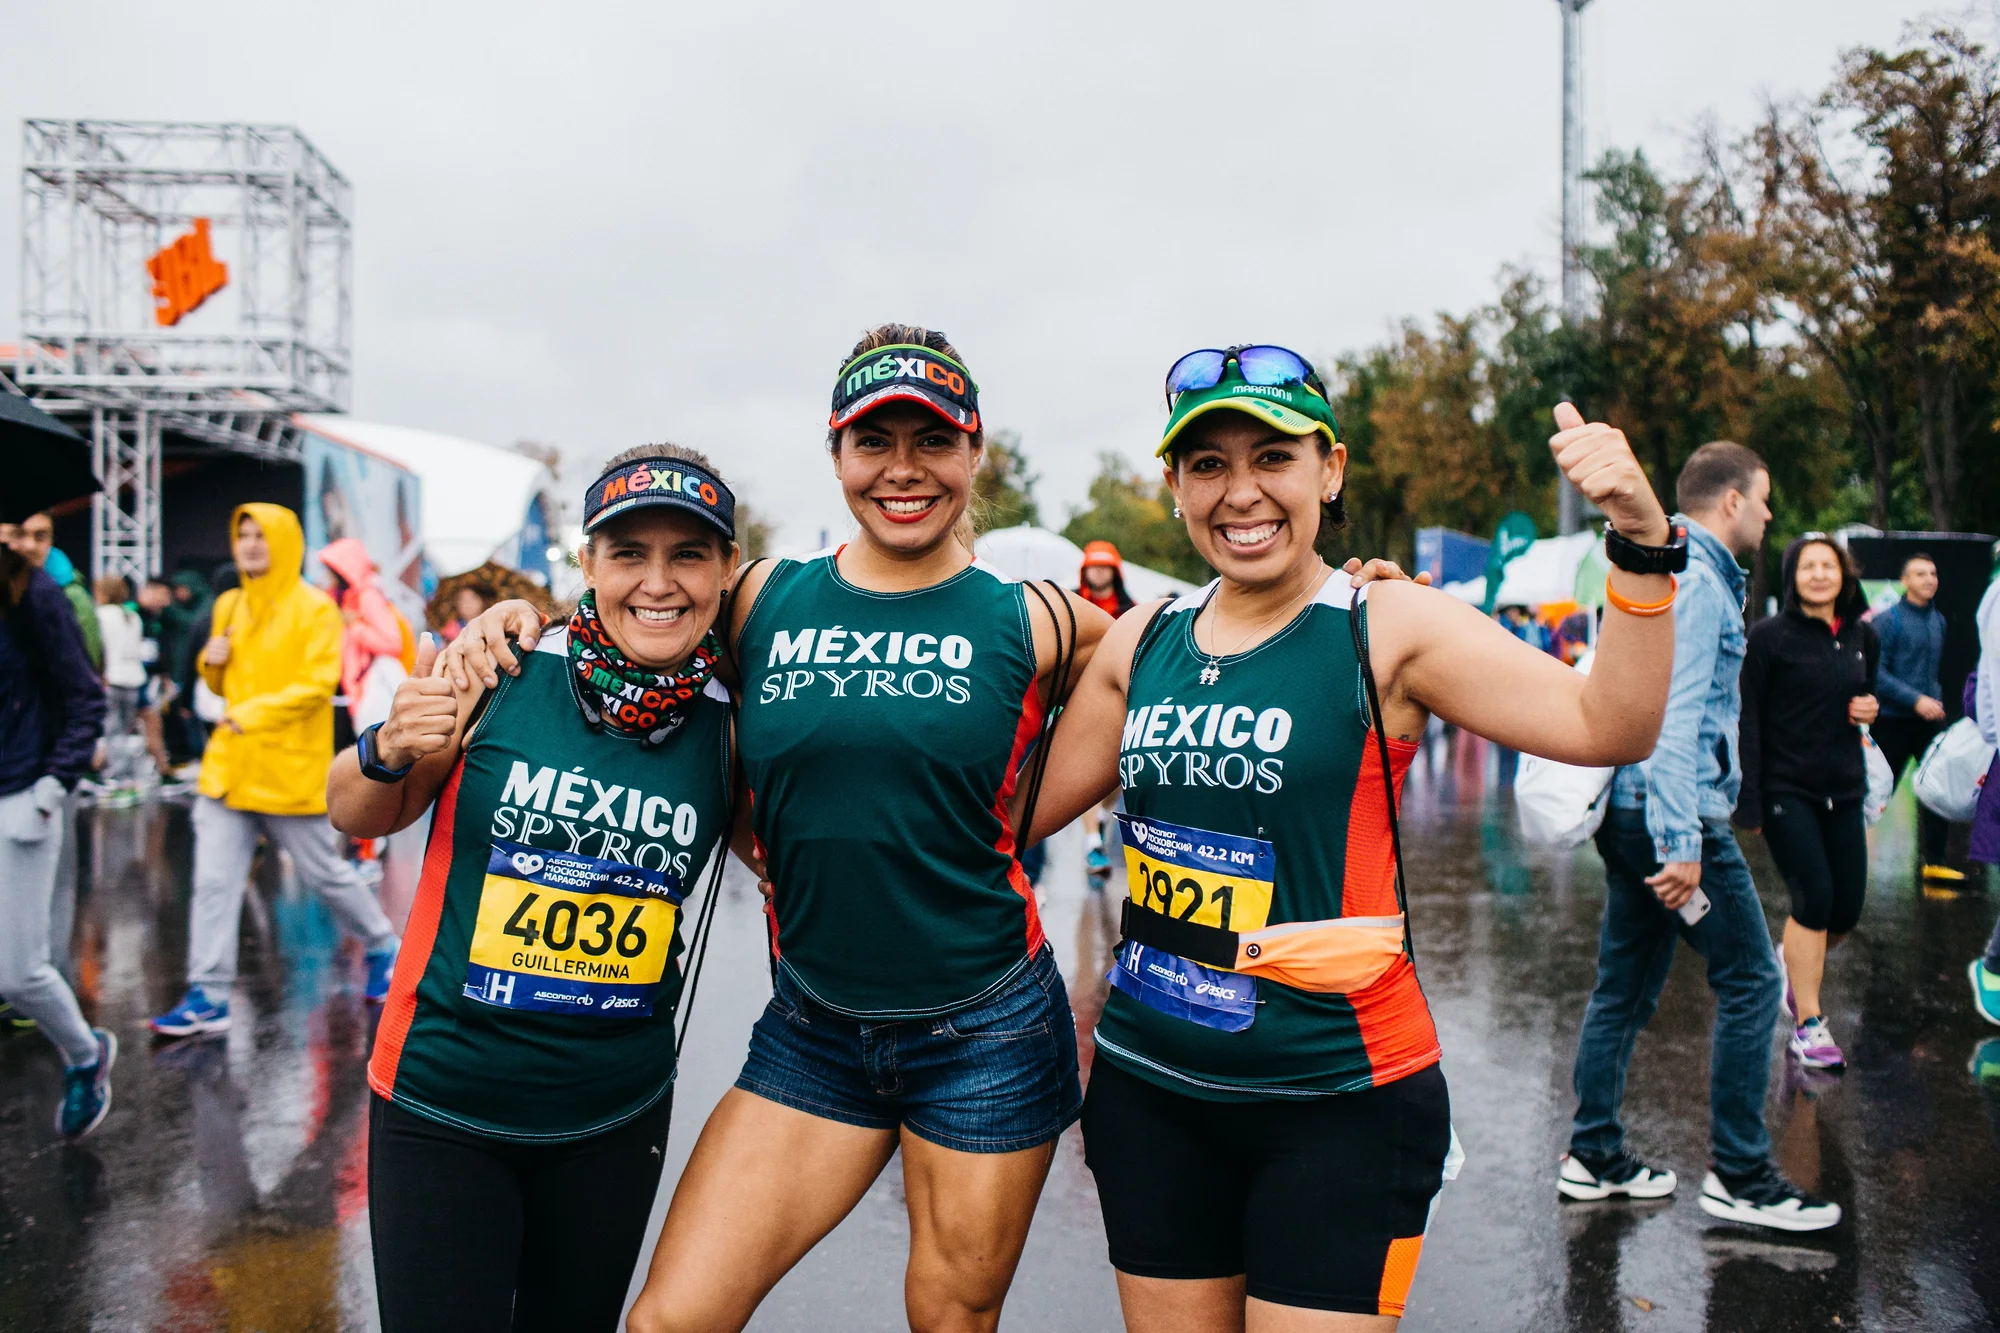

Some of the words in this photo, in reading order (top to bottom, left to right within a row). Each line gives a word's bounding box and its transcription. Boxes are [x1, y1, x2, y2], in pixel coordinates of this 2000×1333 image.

[767, 625, 973, 669] MÉXICO
[760, 669, 971, 704] SPYROS
[1120, 697, 1293, 753] MÉXICO
[1119, 751, 1284, 794] SPYROS
[500, 760, 698, 847] MÉXICO
[491, 806, 692, 881] SPYROS
[1197, 845, 1228, 861] 42,2
[543, 872, 591, 888] МАРАФОН
[545, 864, 610, 882] МОСКОВСКИЙ
[613, 875, 643, 890] 42,2
[547, 858, 594, 870] АБСОЛЮТ
[503, 892, 647, 958] 4036
[512, 952, 630, 979] GUILLERMINA
[489, 973, 516, 1005] H
